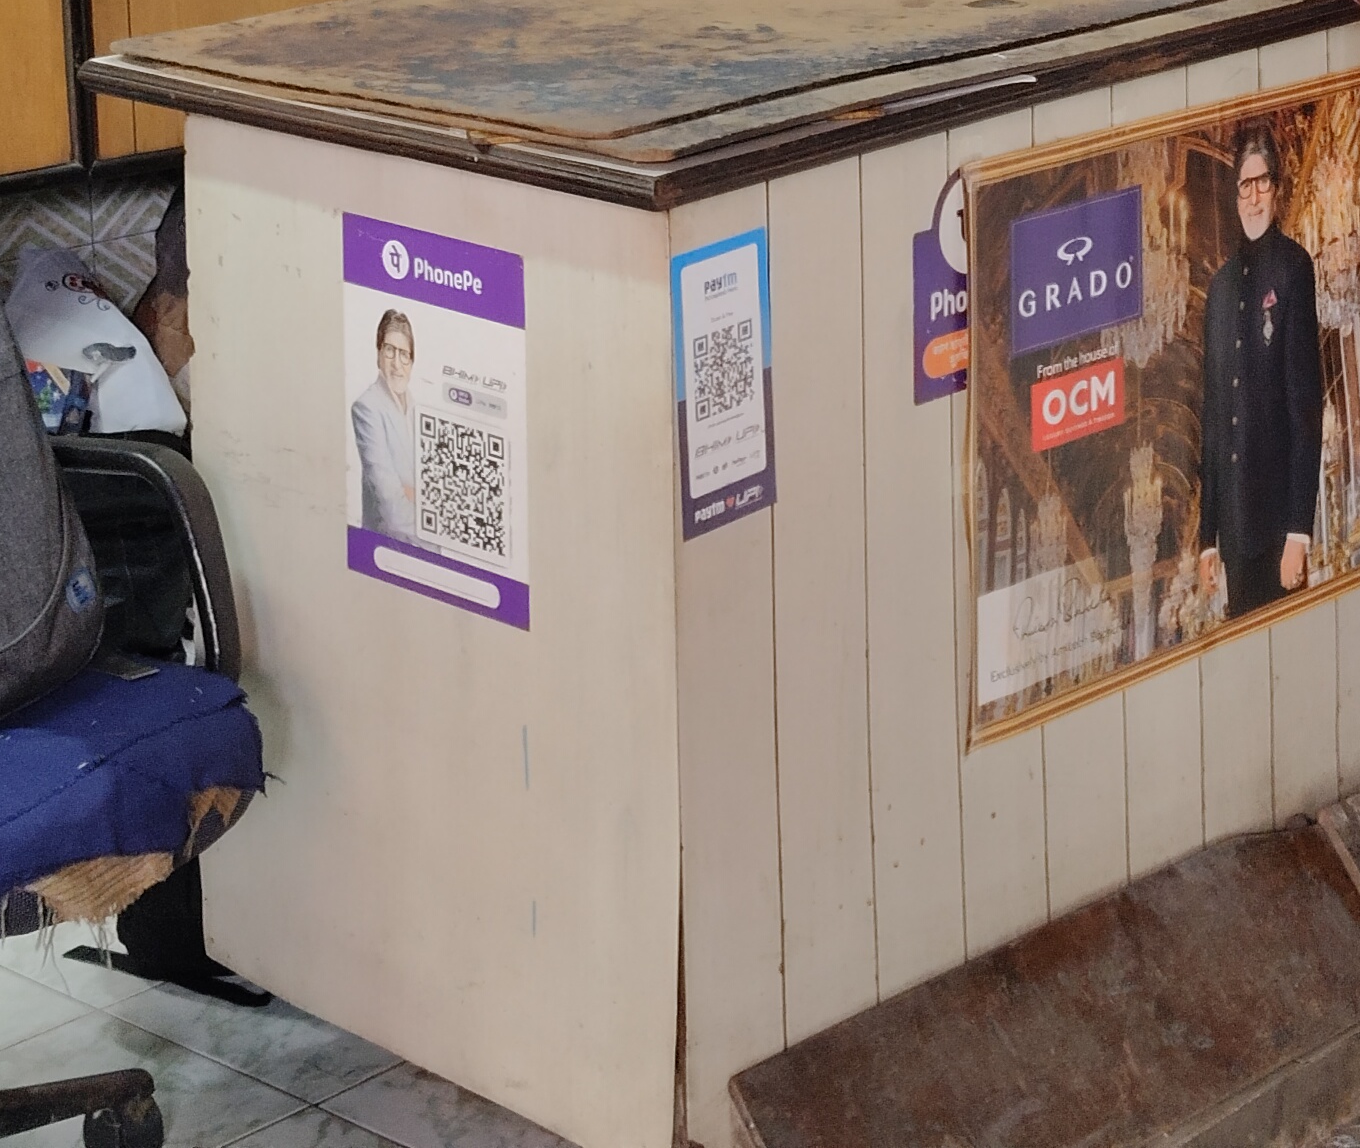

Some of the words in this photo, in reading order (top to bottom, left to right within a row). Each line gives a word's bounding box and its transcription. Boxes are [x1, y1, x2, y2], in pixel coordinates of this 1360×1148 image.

[414, 257, 483, 295] PhonePe
[1018, 261, 1133, 318] GRADO
[1036, 364, 1063, 379] From
[1064, 355, 1079, 371] the
[1080, 347, 1109, 364] house
[1042, 371, 1115, 425] OCM
